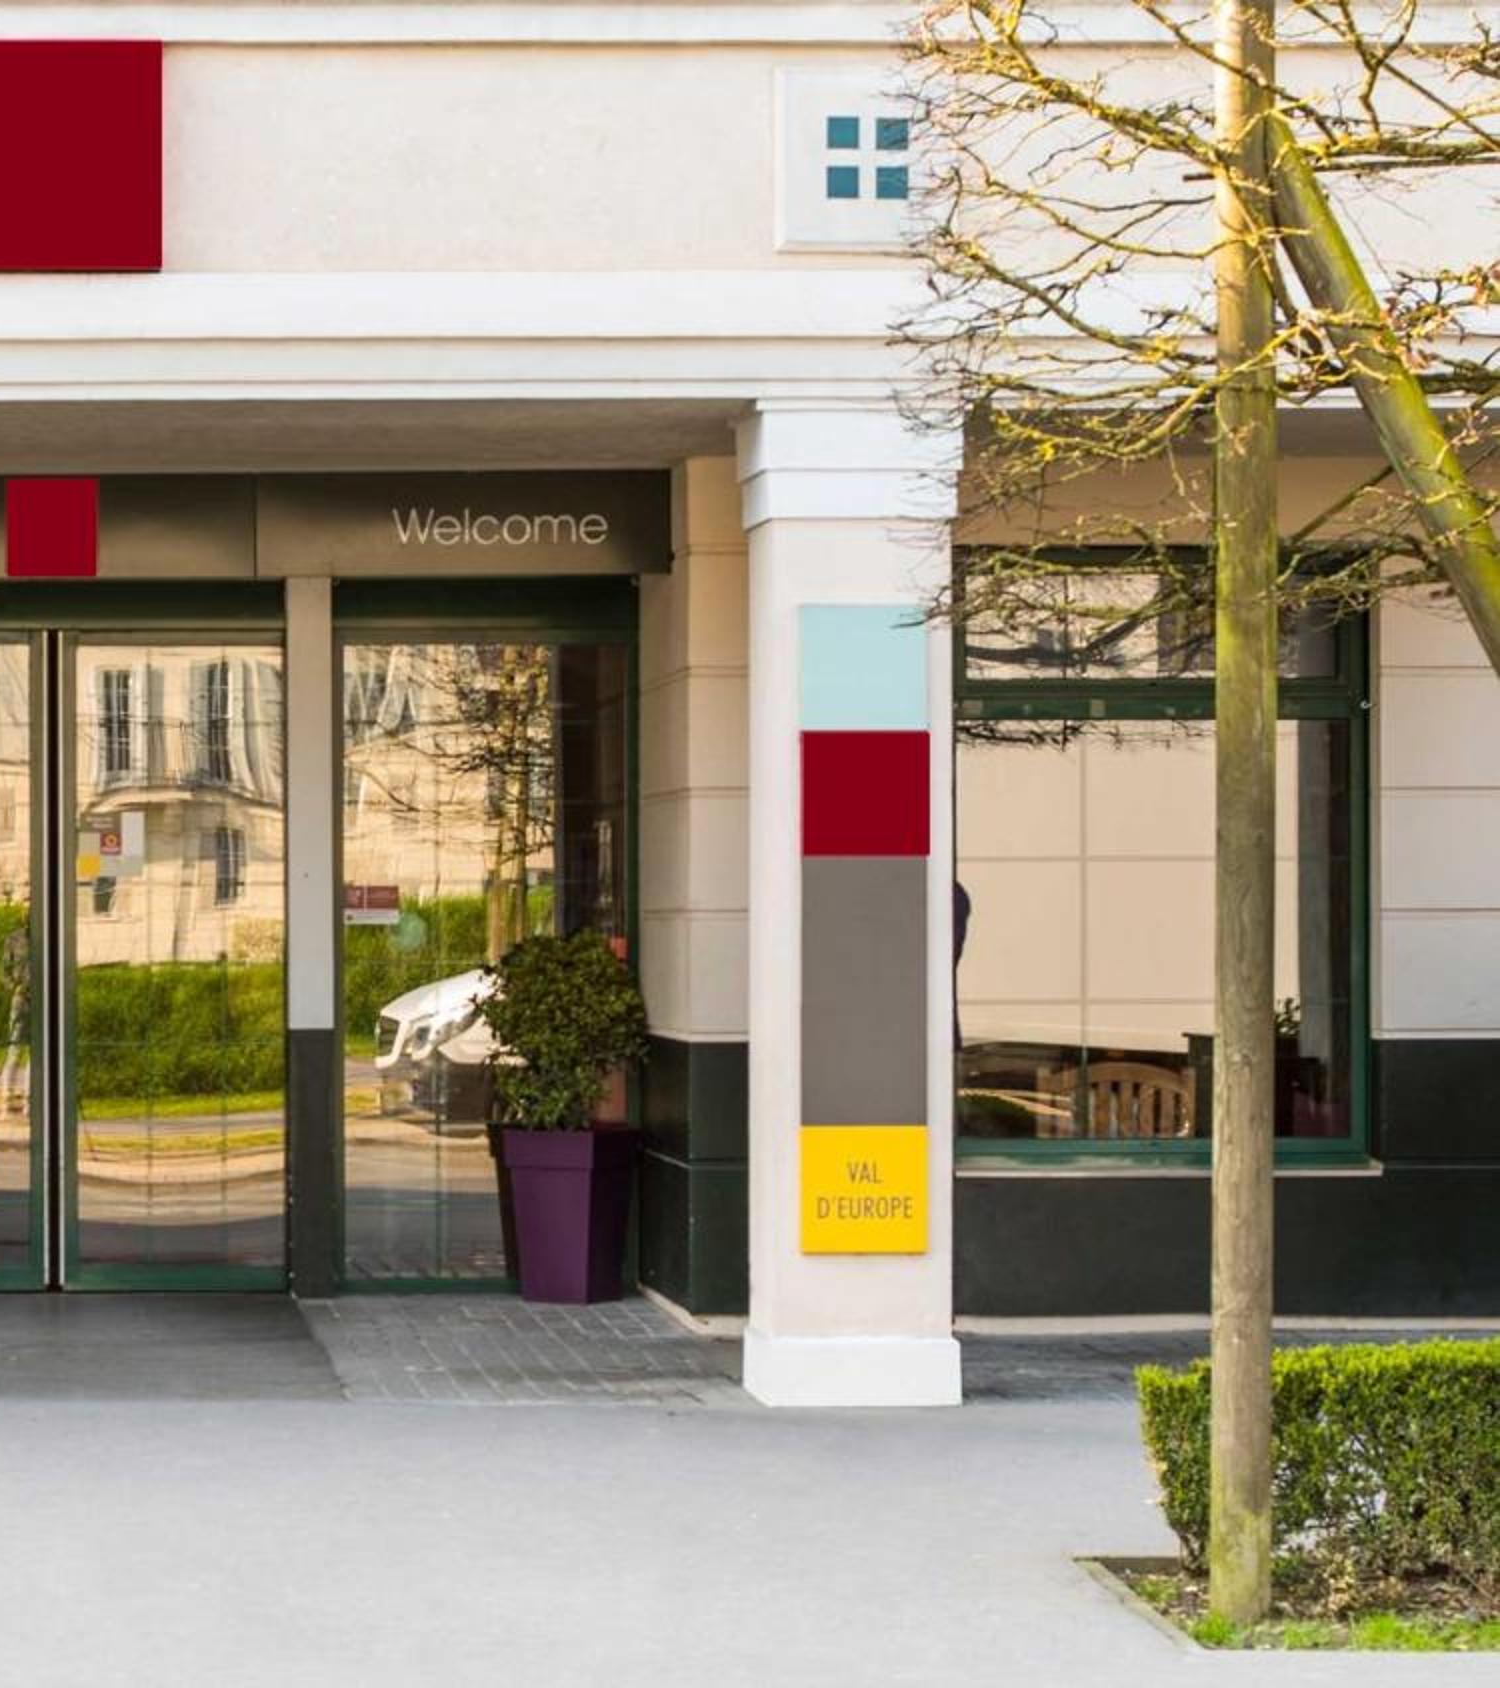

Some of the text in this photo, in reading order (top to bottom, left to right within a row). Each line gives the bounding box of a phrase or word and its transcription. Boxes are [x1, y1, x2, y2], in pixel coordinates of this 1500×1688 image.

[392, 508, 608, 545] Welcome
[847, 1161, 882, 1184] VAL
[816, 1197, 913, 1219] D'EUROPE
